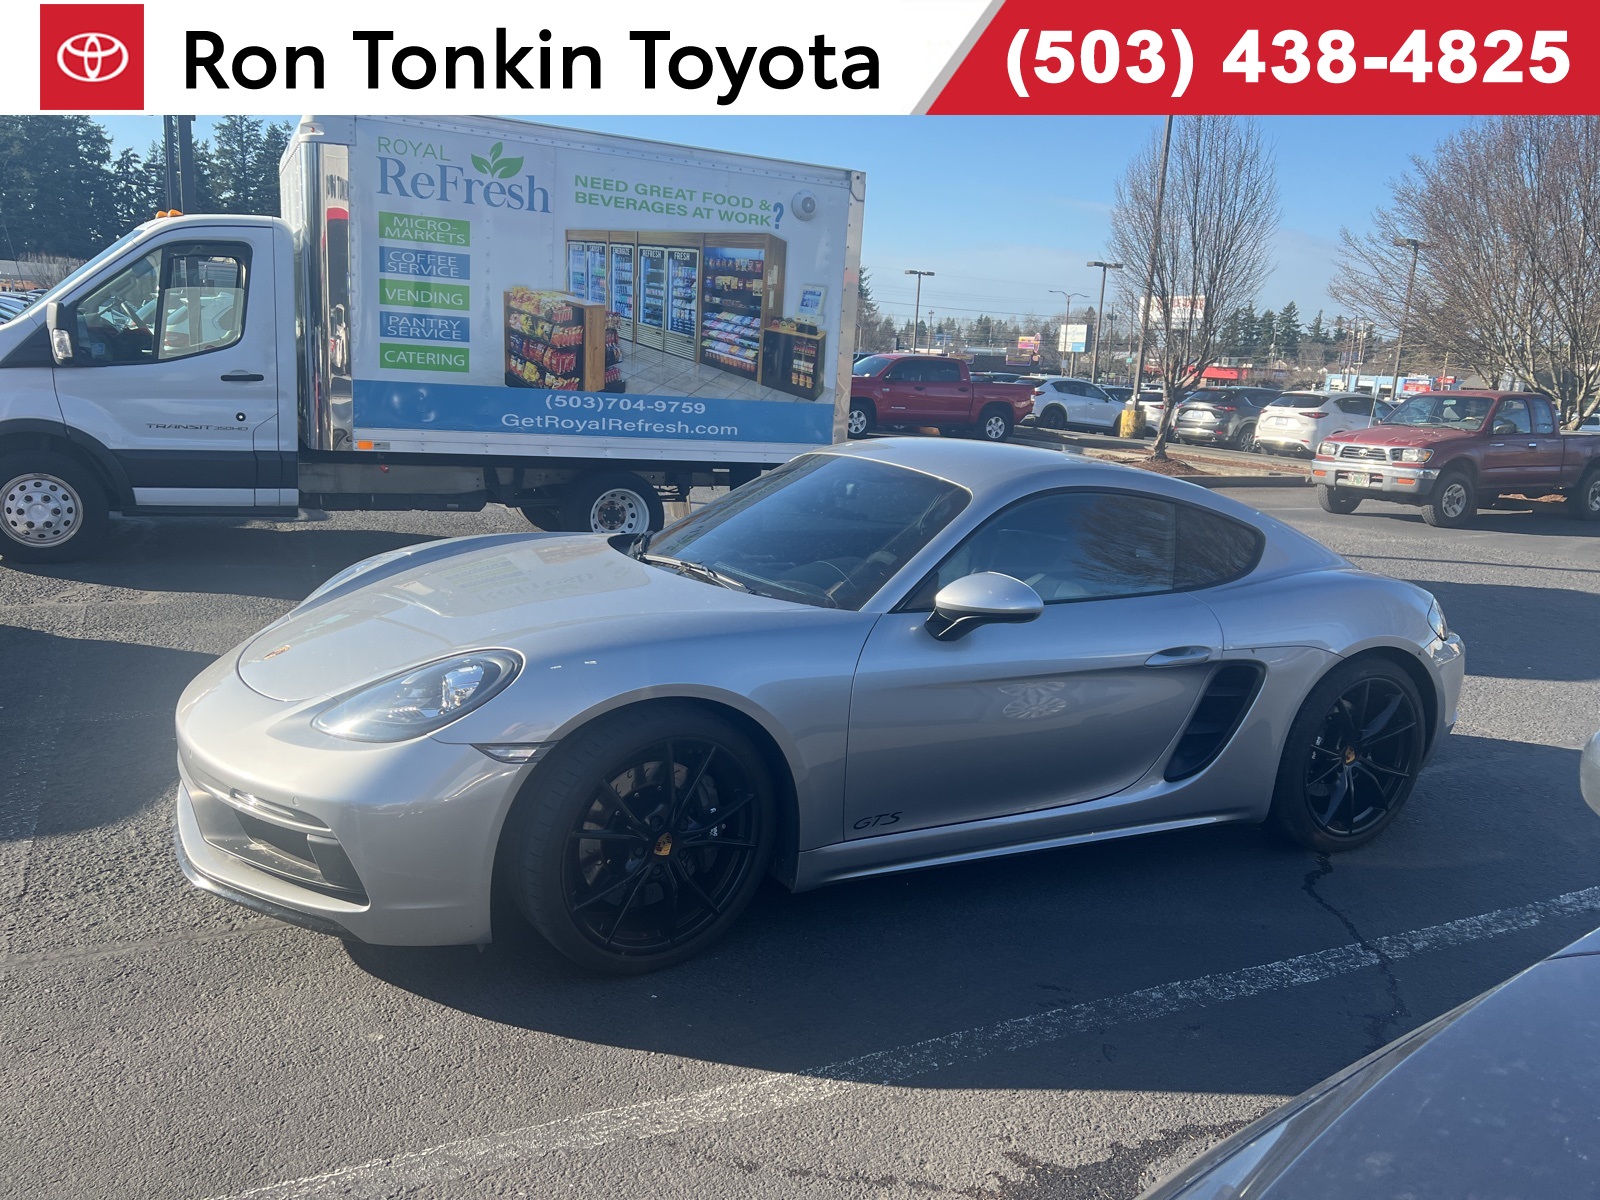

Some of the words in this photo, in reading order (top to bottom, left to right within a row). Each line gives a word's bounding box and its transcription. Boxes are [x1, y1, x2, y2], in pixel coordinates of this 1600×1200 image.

[378, 136, 452, 162] ROYAL
[376, 156, 552, 213] ReFresh
[574, 174, 629, 193] NEED
[634, 183, 697, 201] GREAT
[702, 191, 754, 209] FOOD
[759, 199, 772, 212] &
[575, 191, 688, 217] BEVERAGES
[692, 206, 714, 220] AT
[393, 216, 459, 232] MICRO-
[384, 226, 466, 245] MARKETS
[389, 251, 458, 267] COFFEE
[642, 249, 662, 259] REFRESH
[674, 252, 691, 261] FRESH
[387, 261, 460, 278] SERVICE
[385, 287, 463, 306] VENDING
[389, 315, 461, 330] PANTRY
[387, 325, 462, 340] SERVICE
[384, 350, 465, 367] CATERING
[545, 394, 706, 415] (503)704-9759
[501, 413, 738, 436] GetRoyalRefresh.com
[853, 811, 903, 830] GTS
